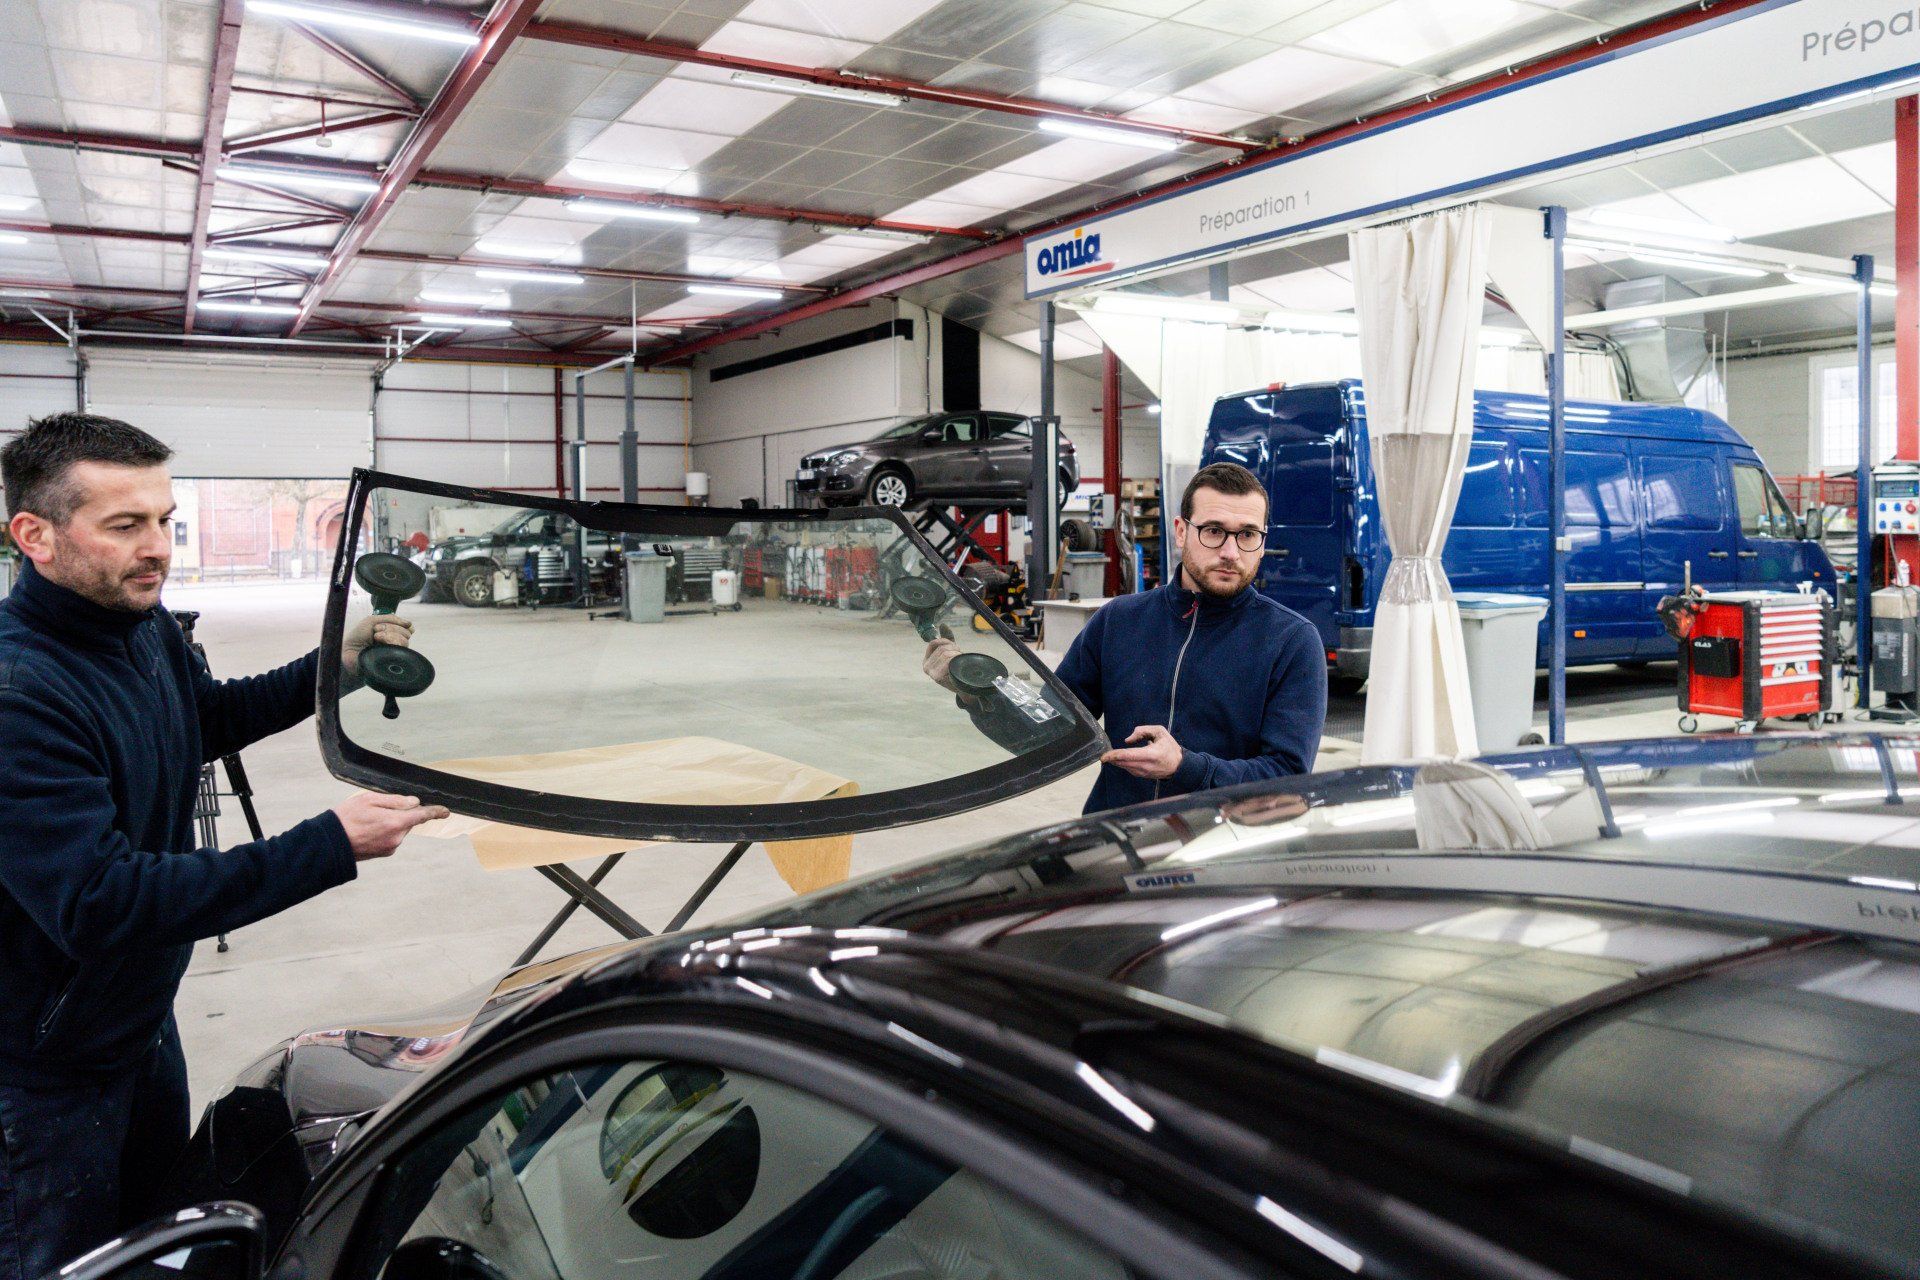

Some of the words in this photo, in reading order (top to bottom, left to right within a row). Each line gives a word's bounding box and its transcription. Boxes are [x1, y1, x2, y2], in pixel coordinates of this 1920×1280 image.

[1803, 9, 1920, 61] Prépa
[1200, 194, 1295, 233] Préparation
[1303, 190, 1310, 206] 1
